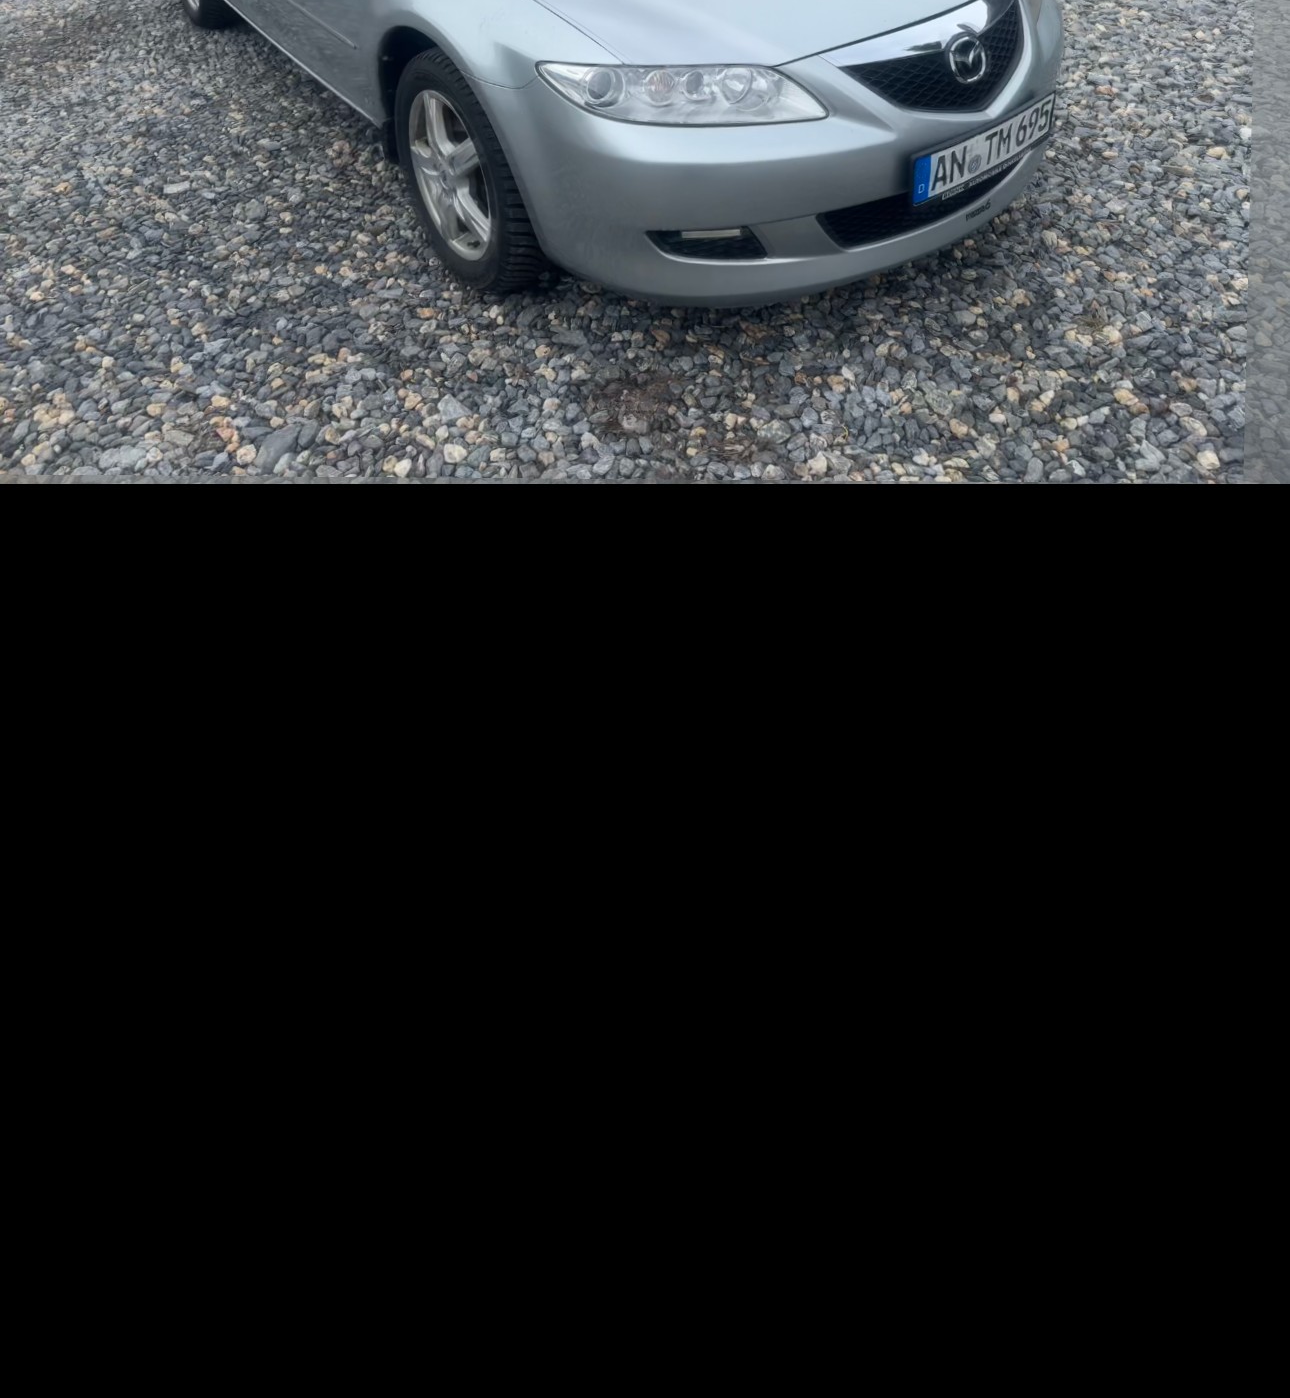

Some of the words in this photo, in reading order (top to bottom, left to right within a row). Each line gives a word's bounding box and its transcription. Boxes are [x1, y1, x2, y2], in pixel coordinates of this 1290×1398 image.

[918, 184, 925, 193] D
[931, 146, 967, 191] AN
[985, 123, 1013, 165] TM
[1016, 100, 1052, 147] 695
